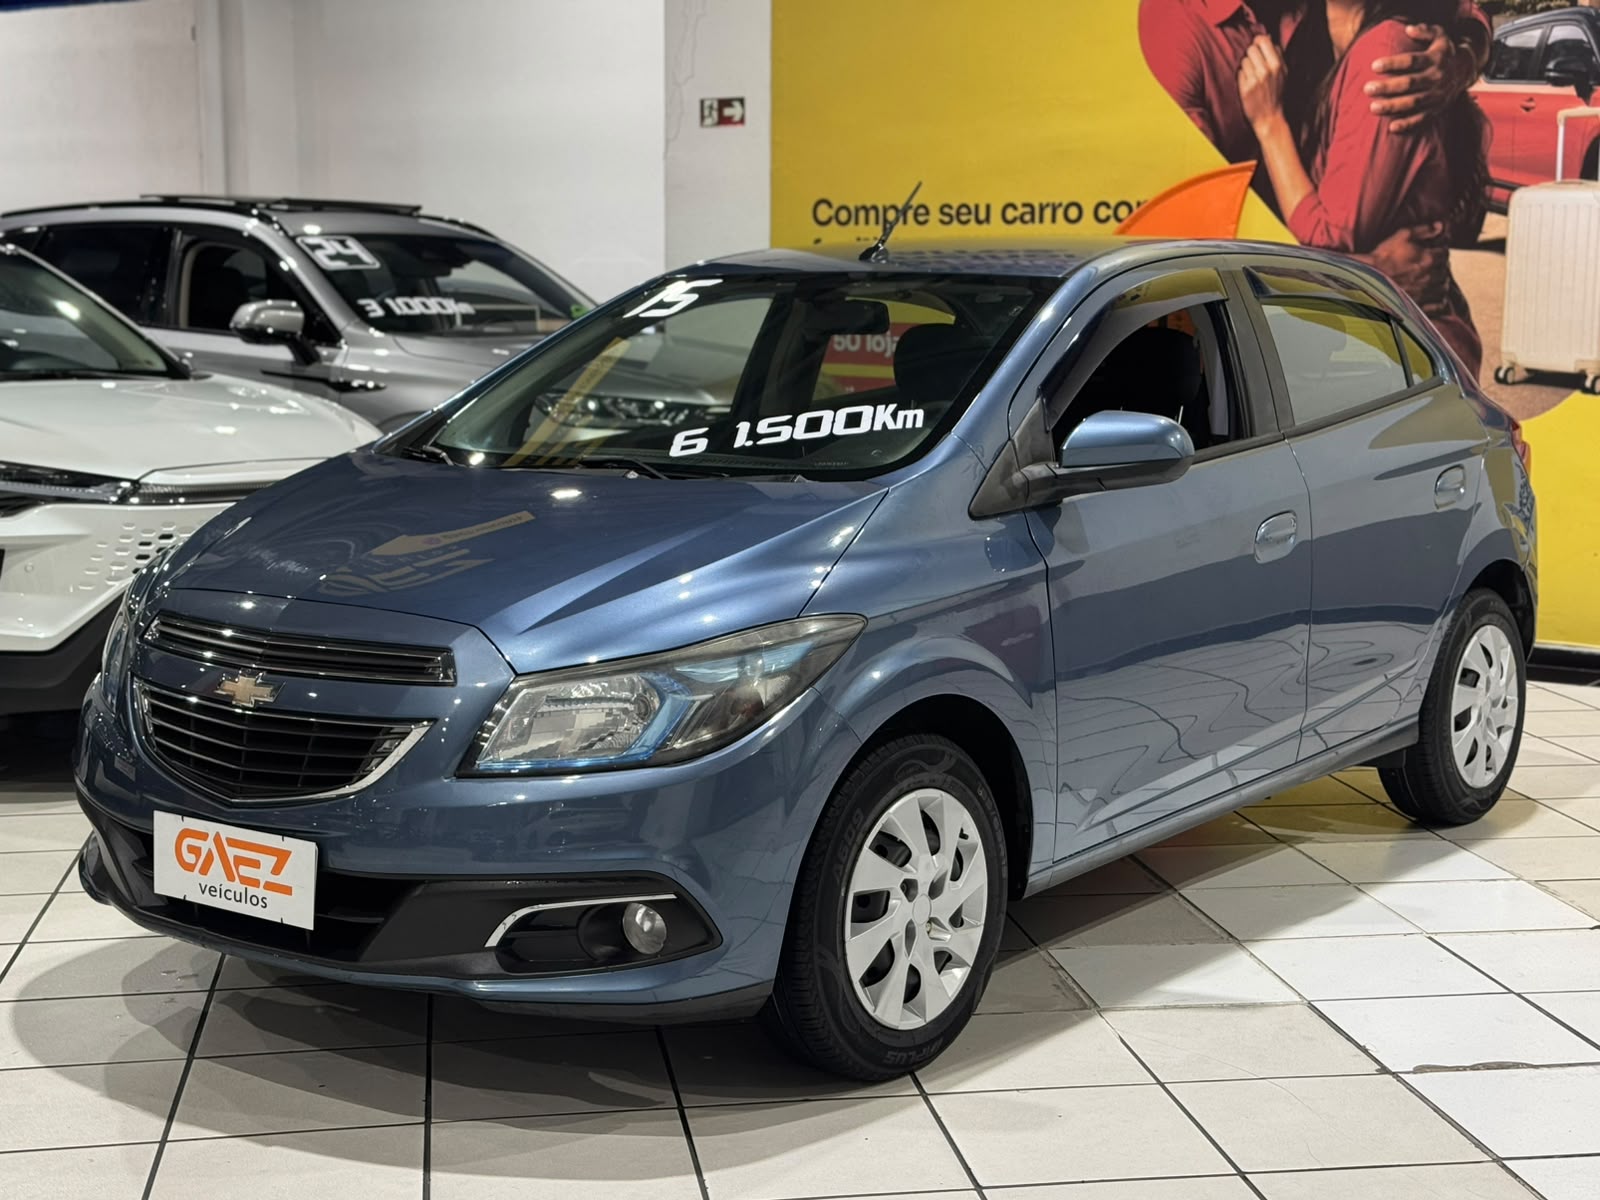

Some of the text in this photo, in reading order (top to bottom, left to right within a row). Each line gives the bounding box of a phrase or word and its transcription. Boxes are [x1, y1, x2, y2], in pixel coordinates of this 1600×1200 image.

[812, 198, 930, 237] Compre
[938, 200, 991, 225] seu
[1000, 200, 1083, 225] carro
[301, 238, 376, 268] 24
[623, 279, 723, 318] 15
[669, 427, 709, 458] 6
[174, 828, 293, 896] GAEZ
[198, 882, 268, 909] veículos
